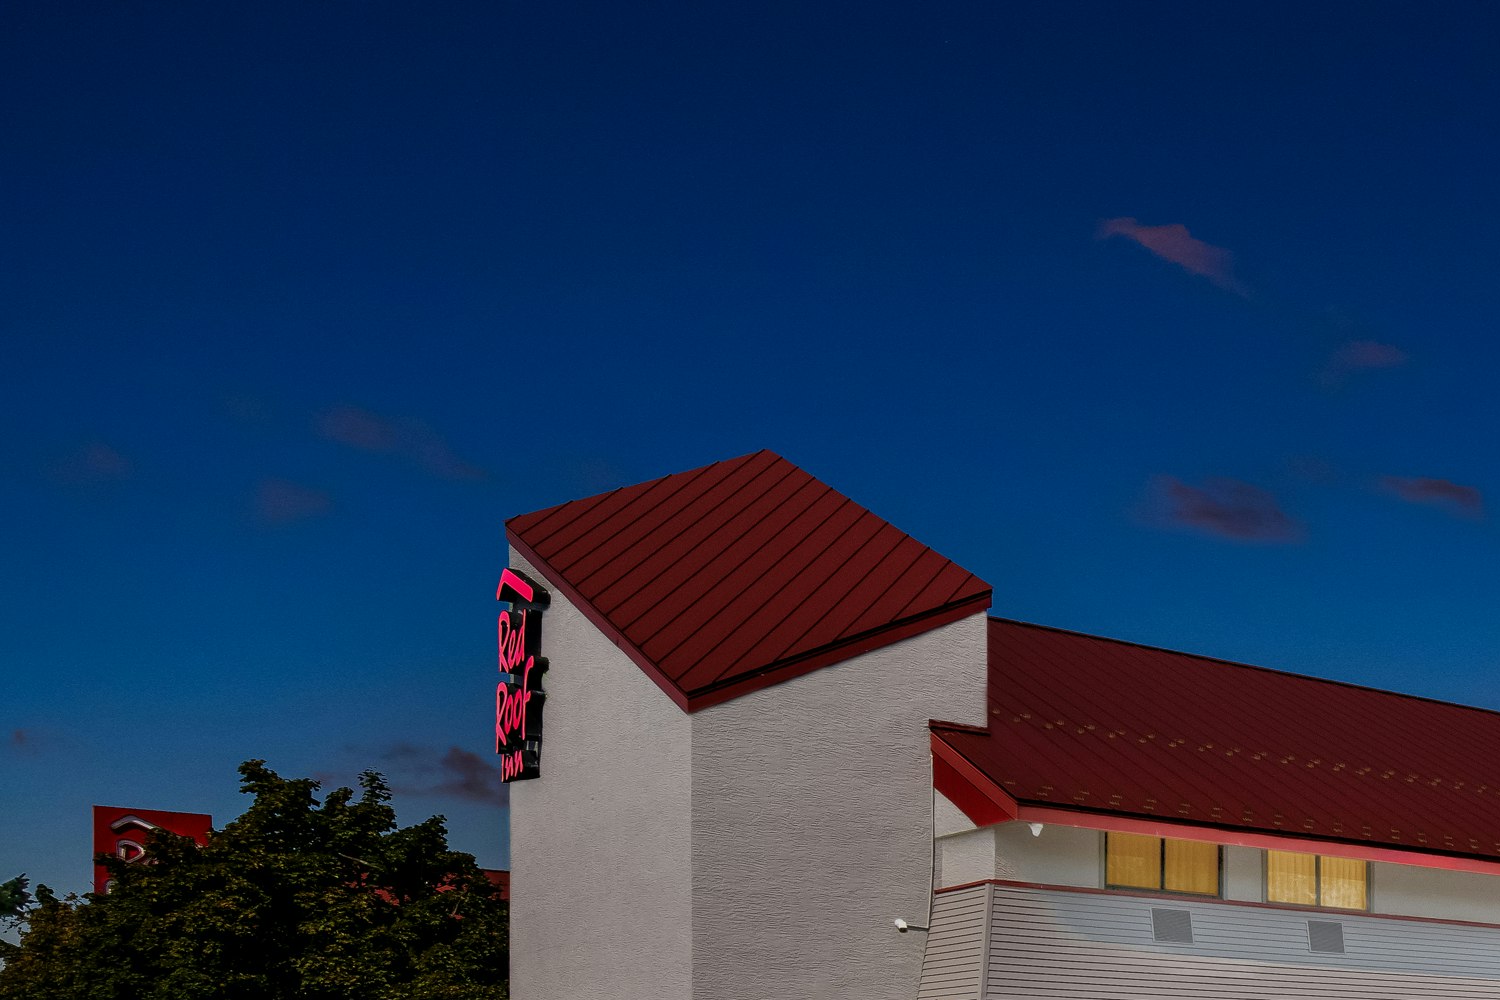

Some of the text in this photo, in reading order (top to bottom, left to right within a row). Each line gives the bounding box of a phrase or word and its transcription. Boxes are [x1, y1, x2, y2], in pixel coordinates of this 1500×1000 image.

[498, 609, 527, 674] Red
[496, 655, 535, 754] Roof
[501, 750, 524, 783] Inn
